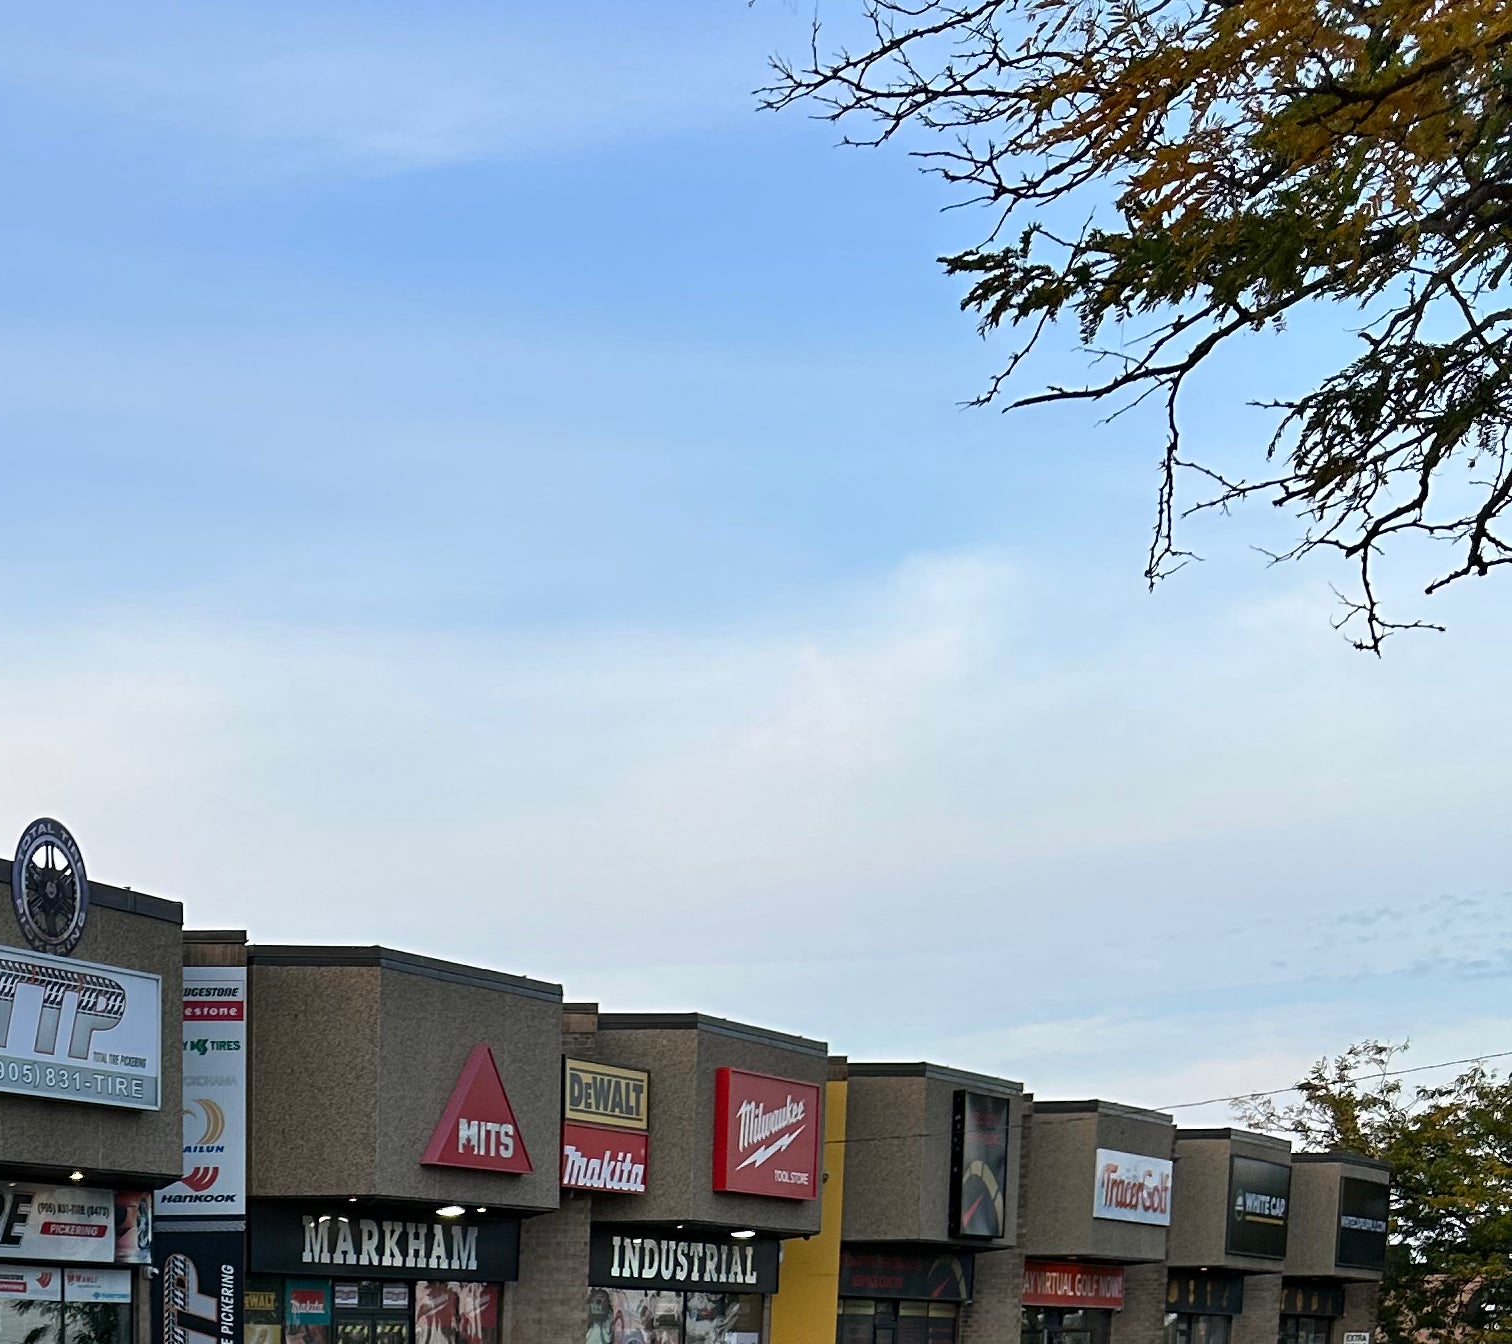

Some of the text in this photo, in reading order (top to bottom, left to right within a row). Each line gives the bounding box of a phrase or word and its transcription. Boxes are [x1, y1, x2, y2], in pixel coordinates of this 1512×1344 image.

[183, 988, 239, 997] DGESTONE
[184, 1007, 238, 1016] estone
[210, 1040, 241, 1051] TIRES
[45, 1067, 144, 1099] 831-TIRE
[184, 1076, 237, 1087] OKOHAMA
[736, 1094, 806, 1152] Milwaukee
[183, 1145, 224, 1154] AILUN
[458, 1118, 514, 1159] MITS
[1245, 1192, 1286, 1217] WHITE CAP
[49, 1224, 98, 1237] PICKERING
[302, 1215, 478, 1270] MARKHAM
[611, 1236, 757, 1284] INDUSTRIAL
[1036, 1272, 1074, 1296] VIRTUAL
[1075, 1273, 1099, 1297] GOLF
[221, 1264, 235, 1335] PICKERING
[245, 1292, 275, 1310] EWALT
